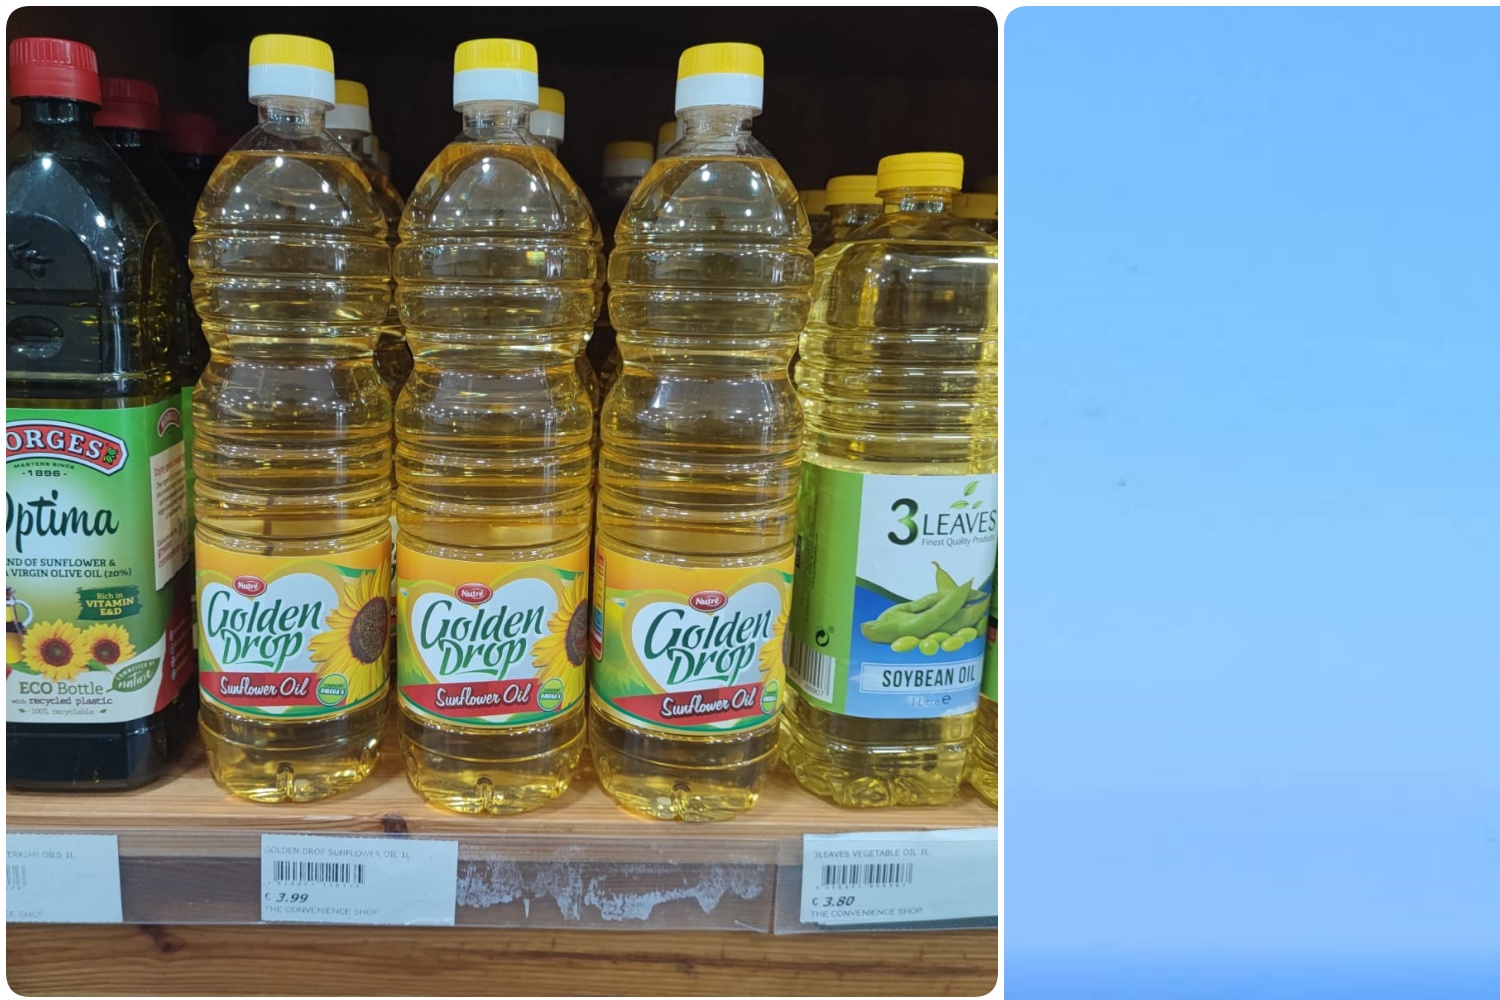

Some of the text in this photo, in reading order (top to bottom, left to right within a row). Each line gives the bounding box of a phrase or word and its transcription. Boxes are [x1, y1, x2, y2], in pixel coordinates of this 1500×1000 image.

[6, 429, 103, 459] ORGES
[887, 498, 997, 546] 3 LEAVES
[921, 536, 945, 547] Finest
[24, 558, 107, 567] OF SUNFLOWER
[12, 569, 49, 578] VIRGIN
[50, 569, 82, 578] OLIVE
[84, 569, 102, 578] OIL
[86, 597, 135, 609] VITAMIN
[96, 592, 114, 600] Rich
[100, 608, 122, 616] E&D
[207, 590, 323, 638] Golden
[420, 599, 546, 649] Golden
[643, 608, 772, 660] Golden
[220, 628, 304, 673] Drop
[437, 637, 528, 682] Drop
[666, 642, 756, 687] Drop
[219, 676, 310, 696] Sunflower Oil
[882, 666, 976, 688] SOYBEAN OIL
[19, 681, 104, 695] ECO Bottle
[435, 683, 532, 707] Sunflower Oil
[29, 696, 114, 706] recycled plastic
[660, 687, 758, 717] Sunflower Oil
[852, 849, 900, 858] VEGETABLE
[275, 892, 309, 903] 3.99
[822, 895, 856, 908] 3.80
